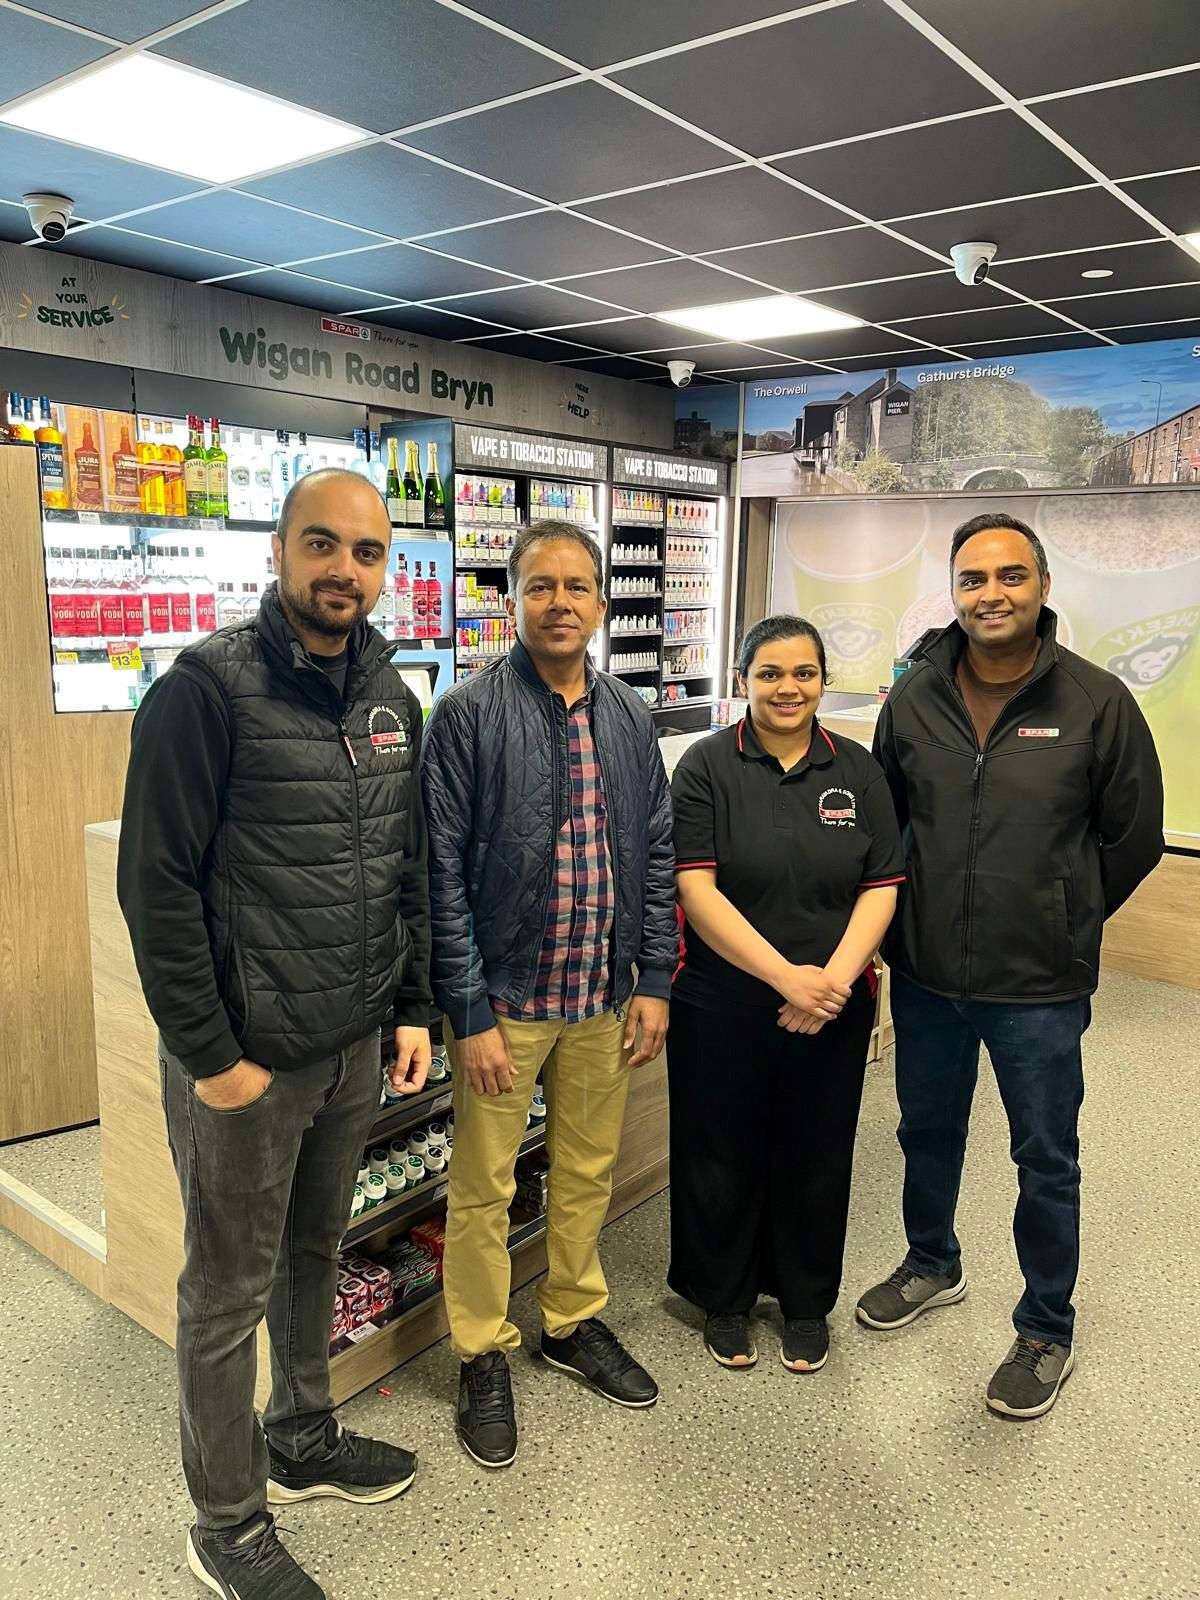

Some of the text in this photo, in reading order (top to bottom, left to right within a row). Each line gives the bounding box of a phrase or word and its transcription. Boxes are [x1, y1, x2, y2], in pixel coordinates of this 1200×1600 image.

[61, 277, 76, 287] AT
[56, 293, 88, 303] YOUR
[37, 305, 114, 328] SERVICE
[330, 322, 360, 335] SPAR
[218, 326, 494, 410] Wigan Road Bryn
[917, 364, 1015, 383] Gathurst Bridge
[754, 383, 807, 397] The Orwell
[577, 394, 585, 402] TO
[888, 401, 909, 409] WIGAN
[567, 400, 590, 419] HELP
[471, 435, 498, 458] VAPE
[510, 441, 555, 465] TOBACCO
[556, 447, 594, 469] STATION
[79, 456, 99, 465] JURA
[624, 457, 645, 476] VAPE
[654, 461, 688, 482] TOBACCO
[688, 465, 718, 485] STATION
